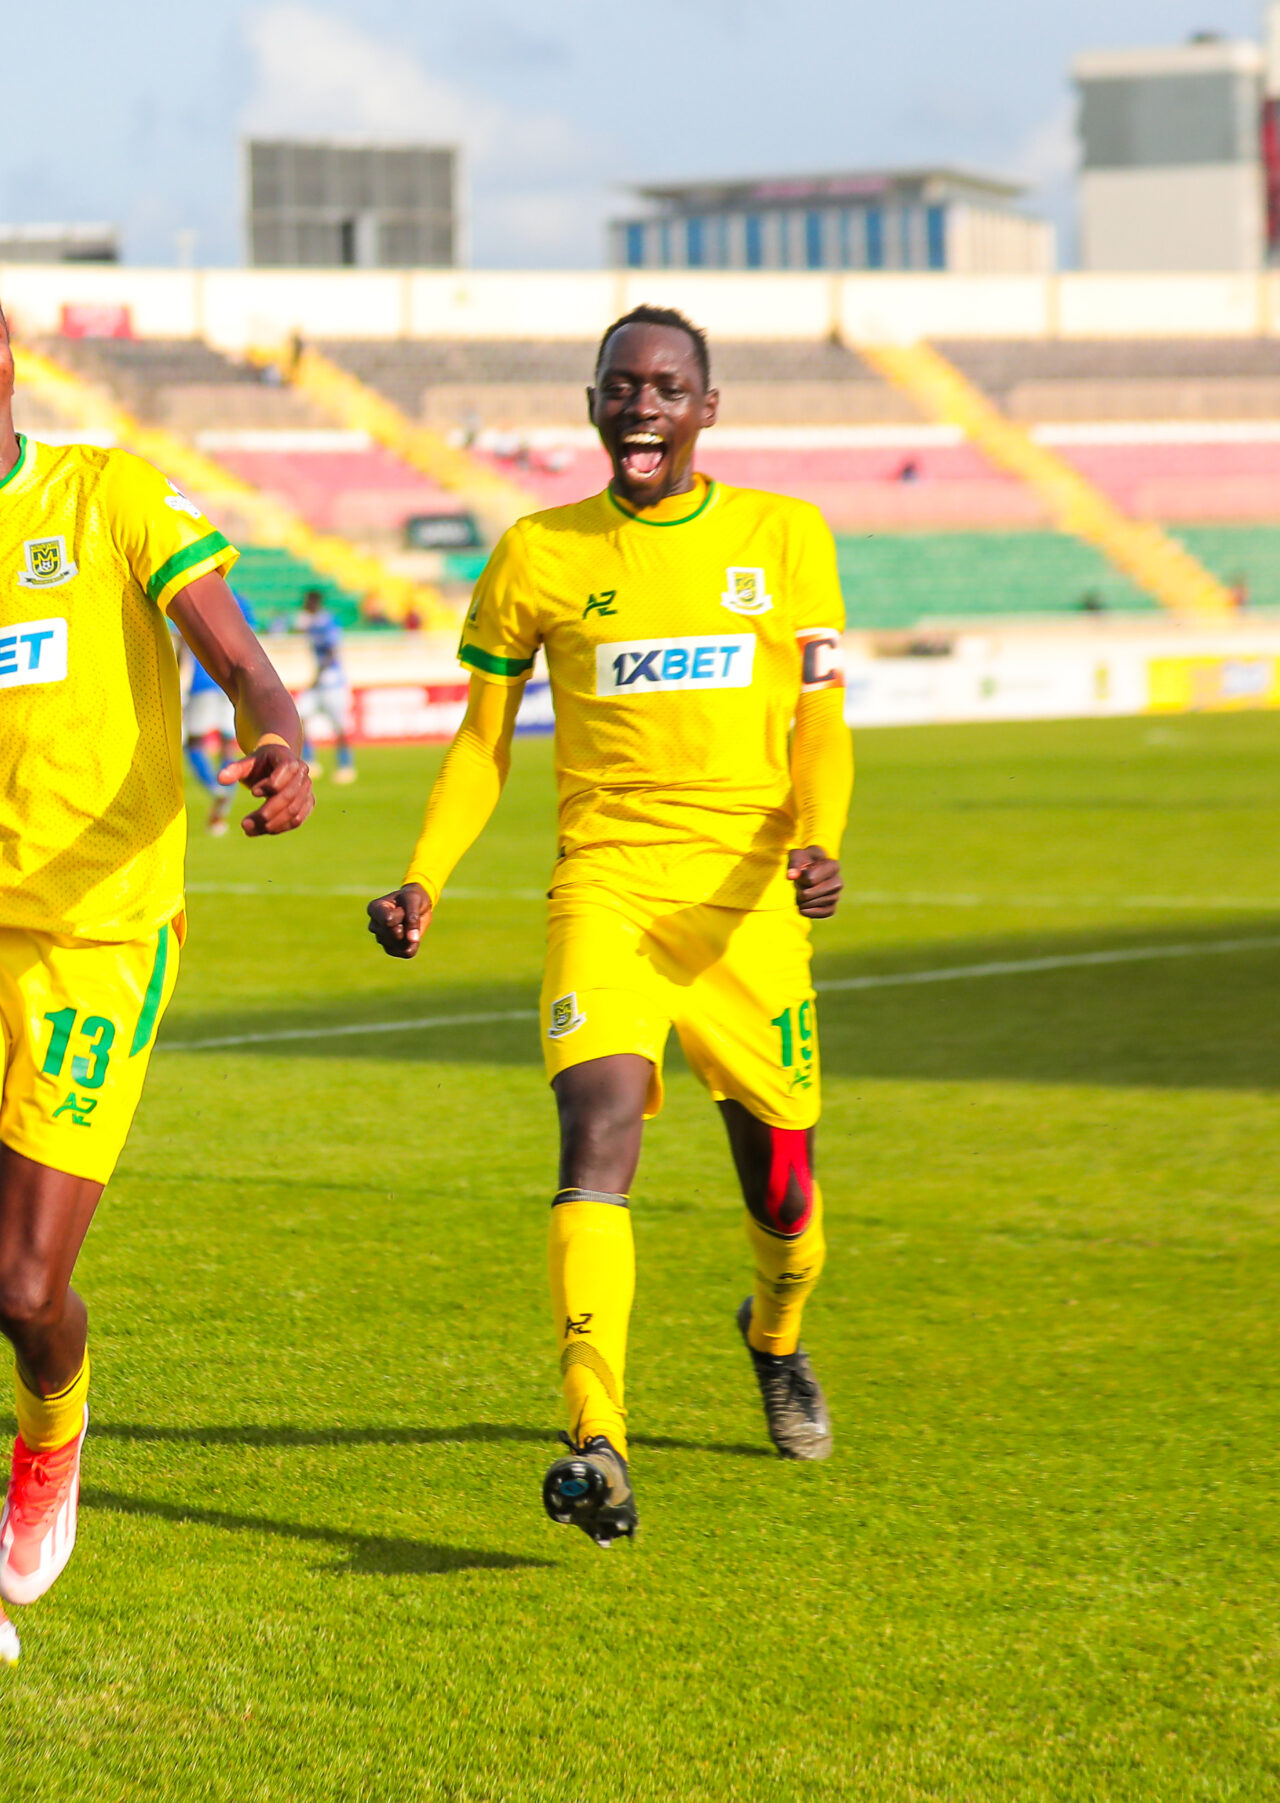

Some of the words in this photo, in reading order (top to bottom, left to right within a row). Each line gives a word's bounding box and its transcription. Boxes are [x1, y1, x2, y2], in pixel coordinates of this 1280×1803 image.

[612, 645, 741, 686] 1XBET
[803, 639, 837, 684] C
[41, 1006, 116, 1089] 13
[770, 999, 813, 1068] 19
